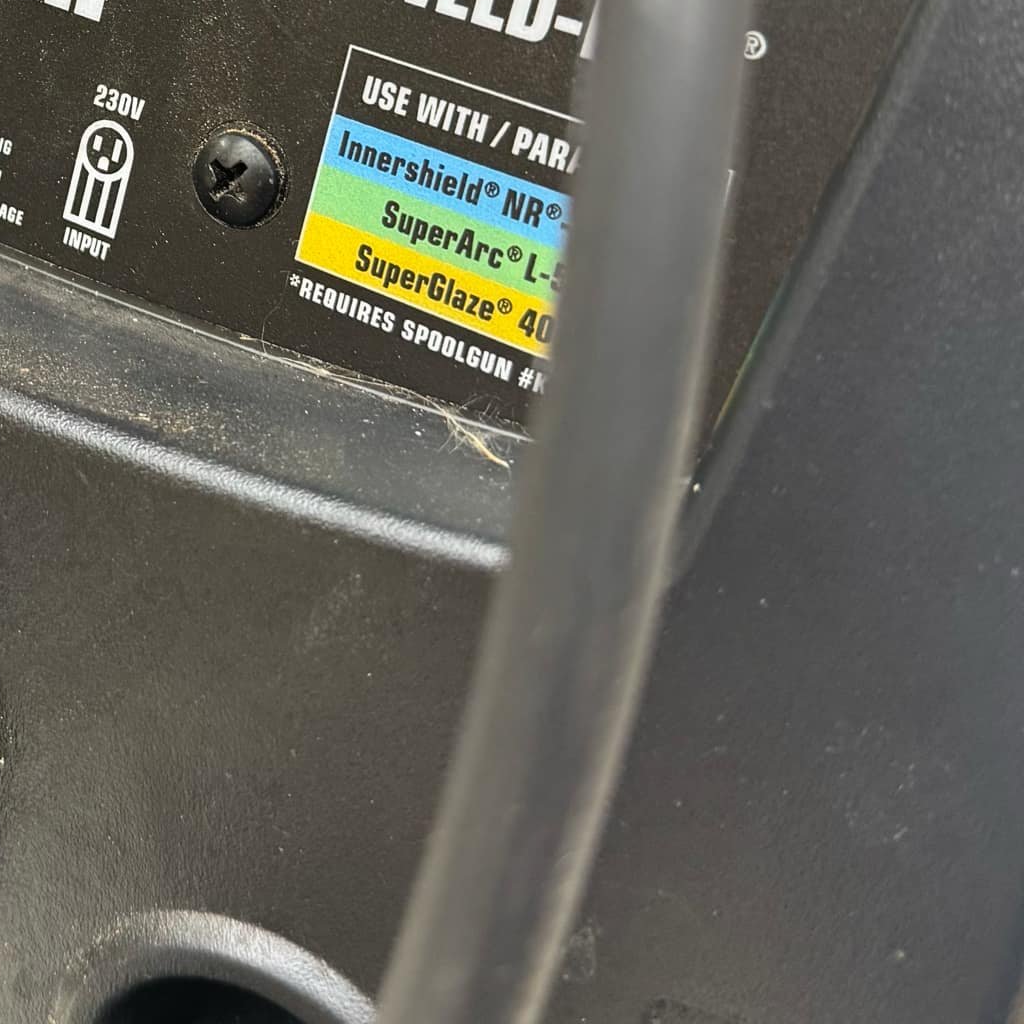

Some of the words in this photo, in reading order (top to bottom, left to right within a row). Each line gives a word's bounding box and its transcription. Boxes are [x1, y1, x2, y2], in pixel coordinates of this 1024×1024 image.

[94, 84, 145, 121] 230V
[362, 75, 411, 116] USE
[417, 93, 490, 144] WITH
[490, 121, 511, 148] /
[63, 227, 110, 261] INPUT
[401, 318, 513, 382] SPOOLGUN
